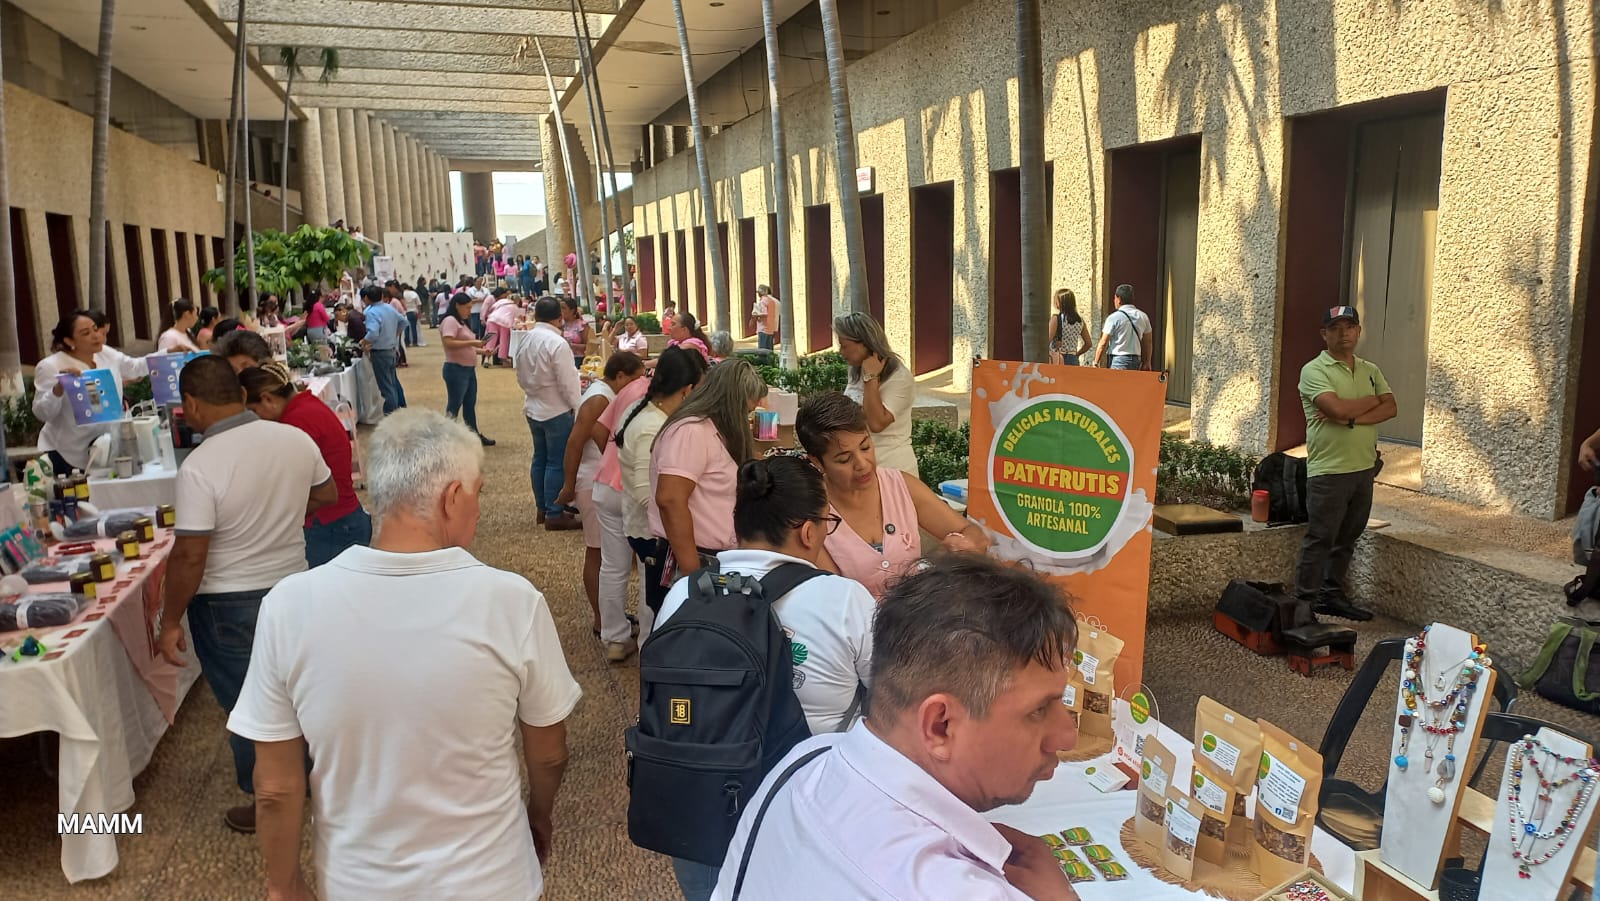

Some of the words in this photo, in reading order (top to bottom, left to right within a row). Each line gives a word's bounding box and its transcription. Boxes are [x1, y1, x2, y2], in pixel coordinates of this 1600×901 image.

[1003, 409, 1051, 452] DELICIAS
[1055, 408, 1121, 463] NATURALES
[1003, 461, 1120, 494] PATYFRUTIS
[1017, 493, 1065, 515] GRANOLA
[1068, 502, 1102, 519] 100%
[1026, 511, 1089, 535] ARTESANAL
